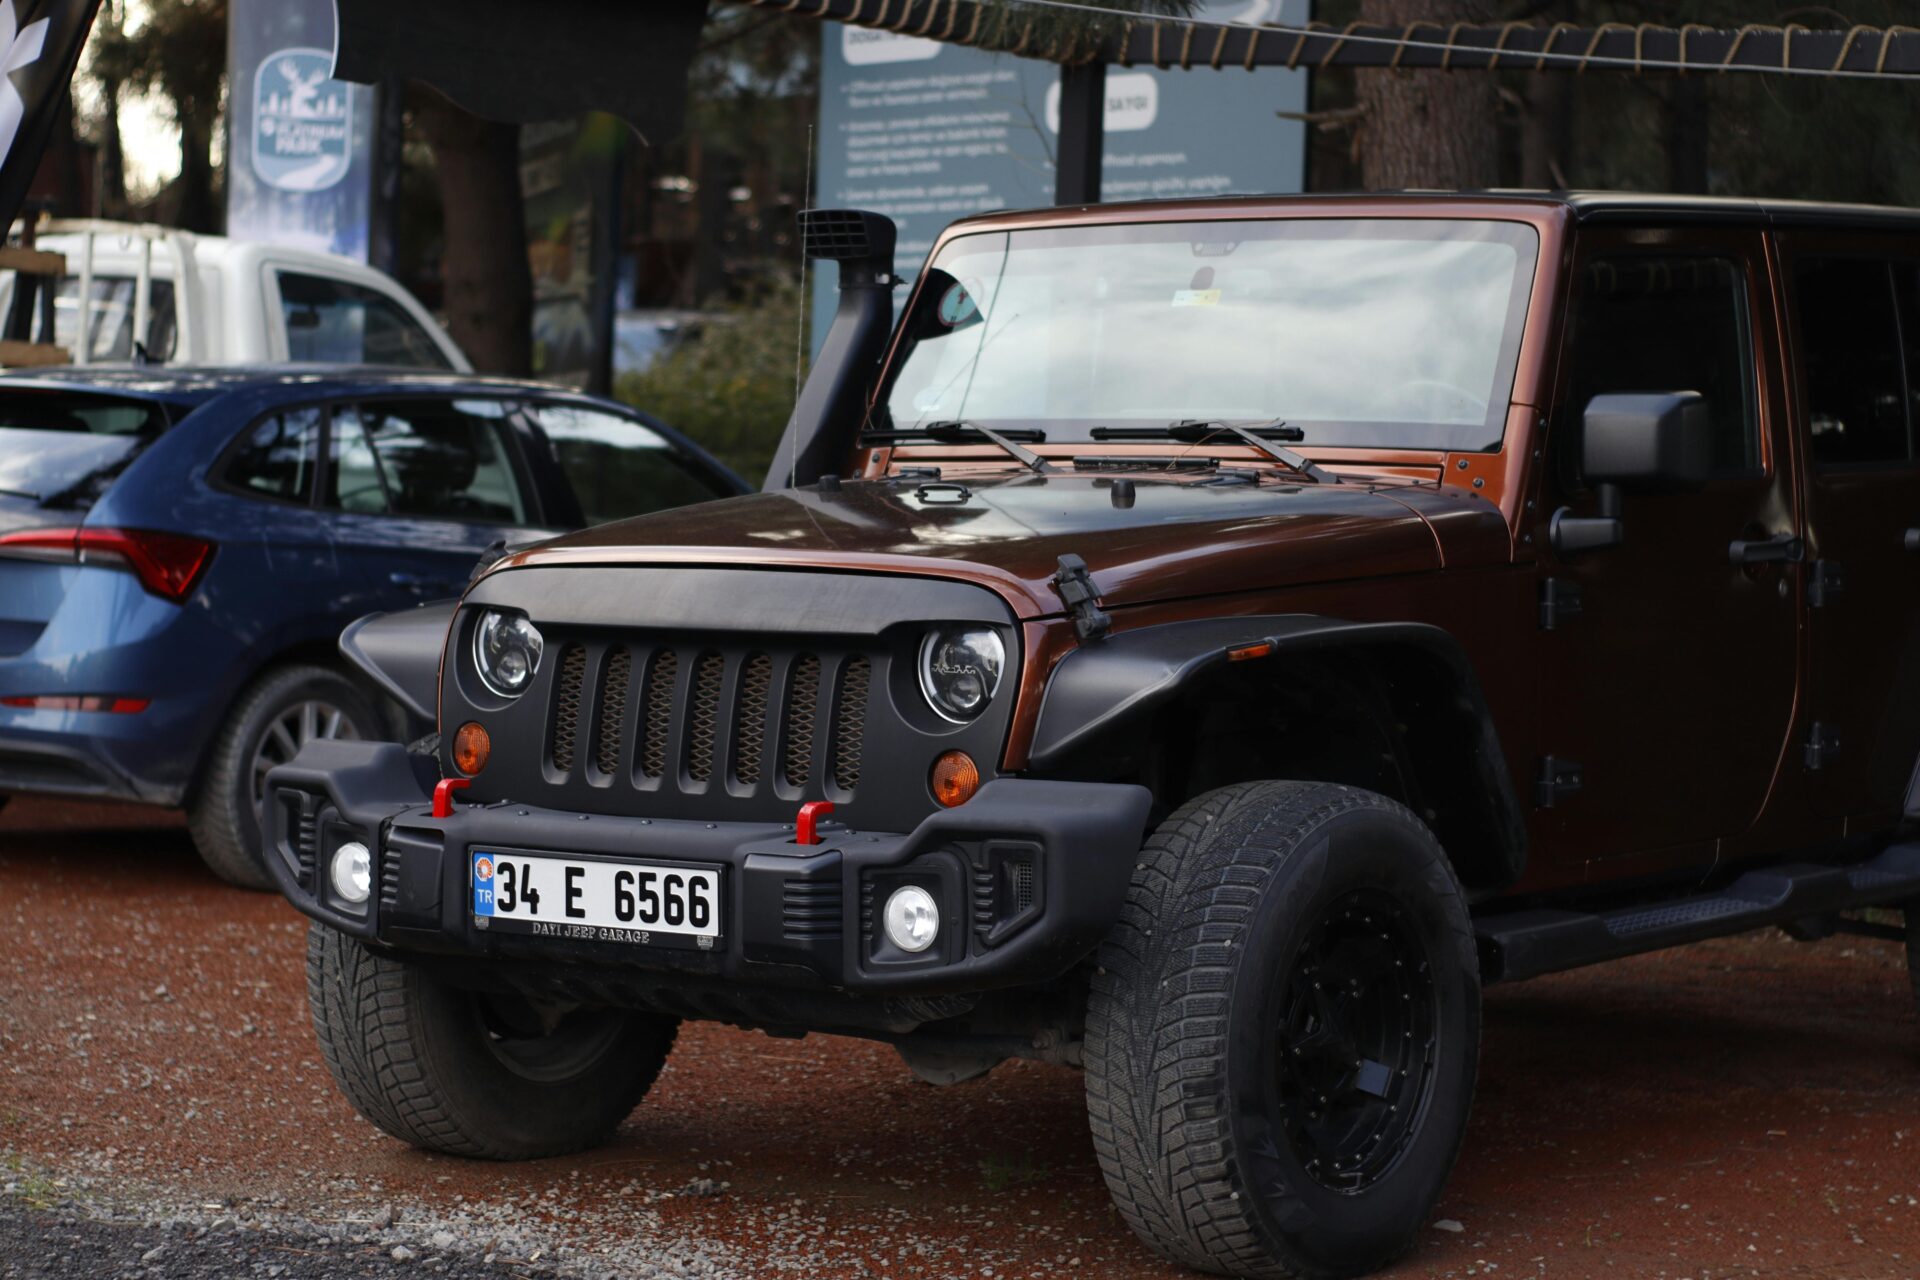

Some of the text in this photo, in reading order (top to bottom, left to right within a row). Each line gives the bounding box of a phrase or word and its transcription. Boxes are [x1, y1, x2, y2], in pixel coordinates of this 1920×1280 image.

[478, 889, 493, 904] TR
[497, 862, 710, 928] 34 E 6566
[532, 922, 650, 944] DAYI JEEP GARAGE
